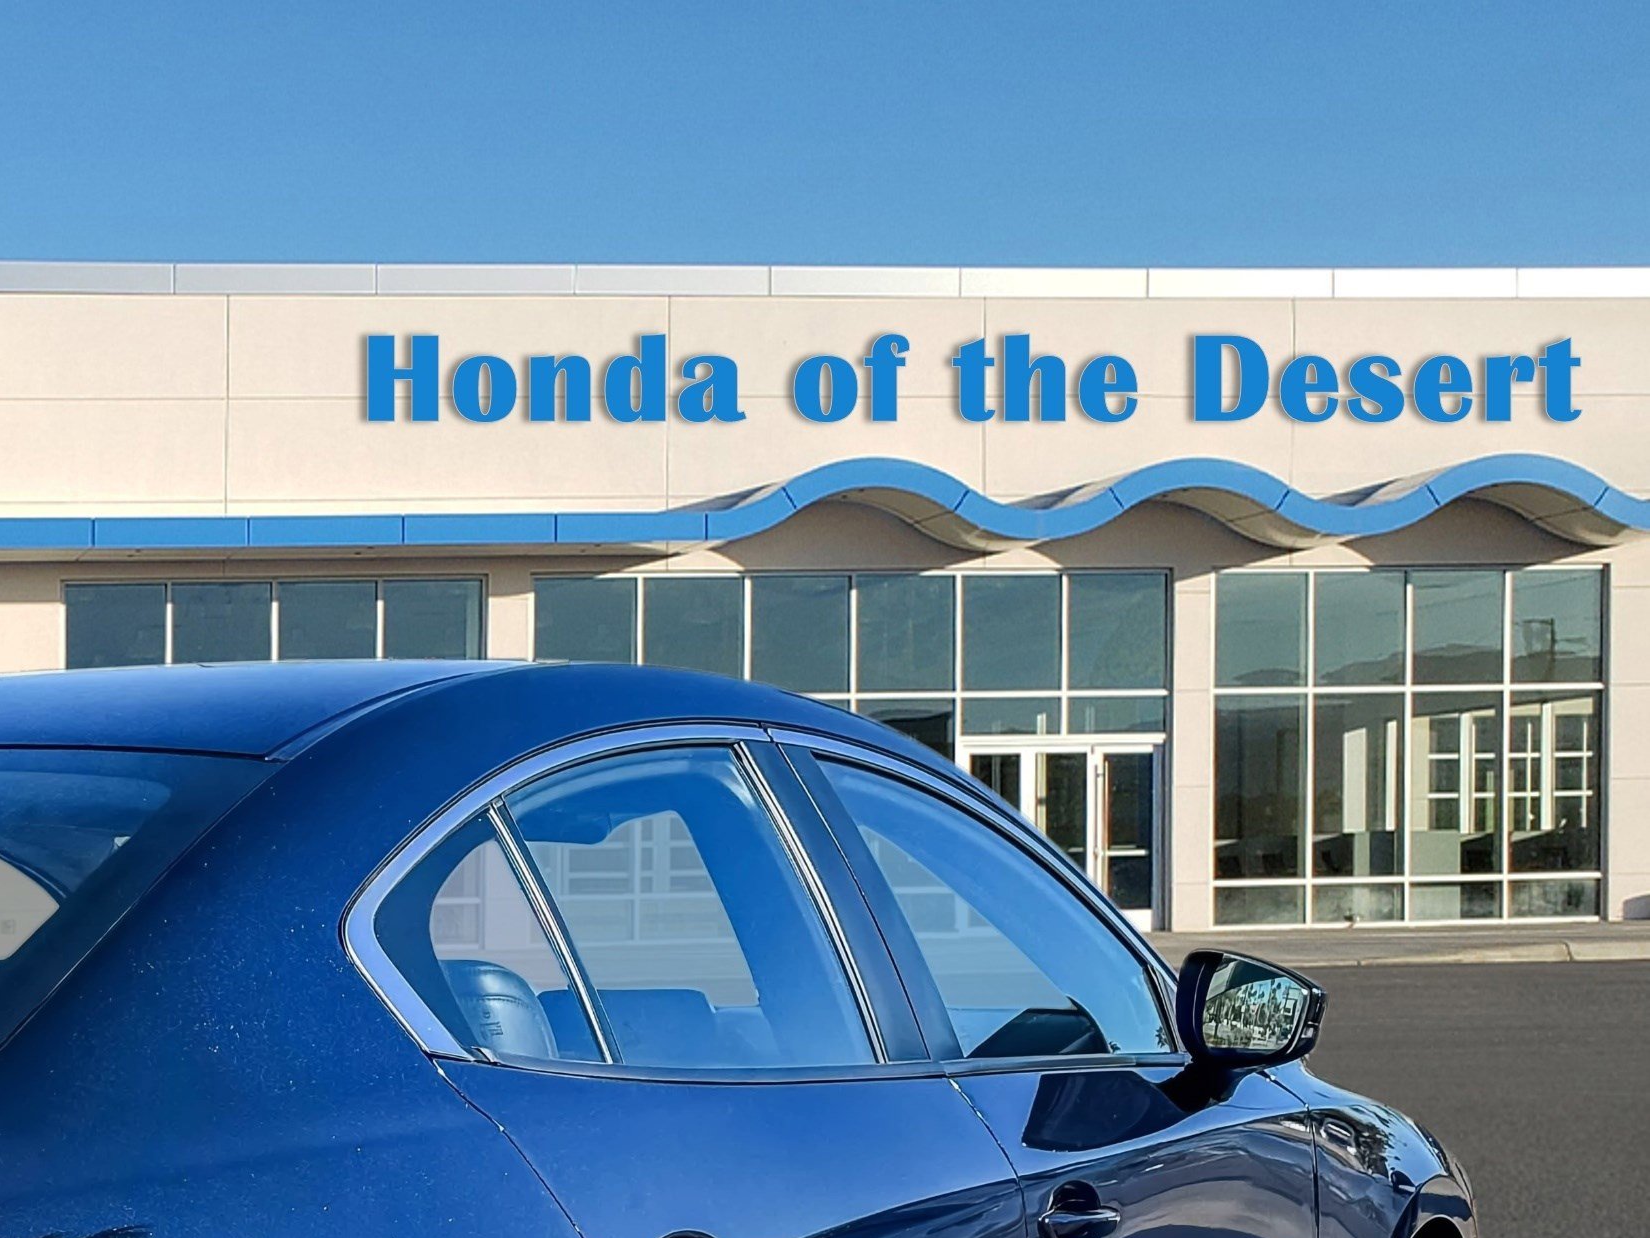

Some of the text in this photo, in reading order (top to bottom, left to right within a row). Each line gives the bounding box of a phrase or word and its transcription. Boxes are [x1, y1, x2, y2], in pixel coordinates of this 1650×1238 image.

[366, 332, 1583, 424] Honda of the Desert
